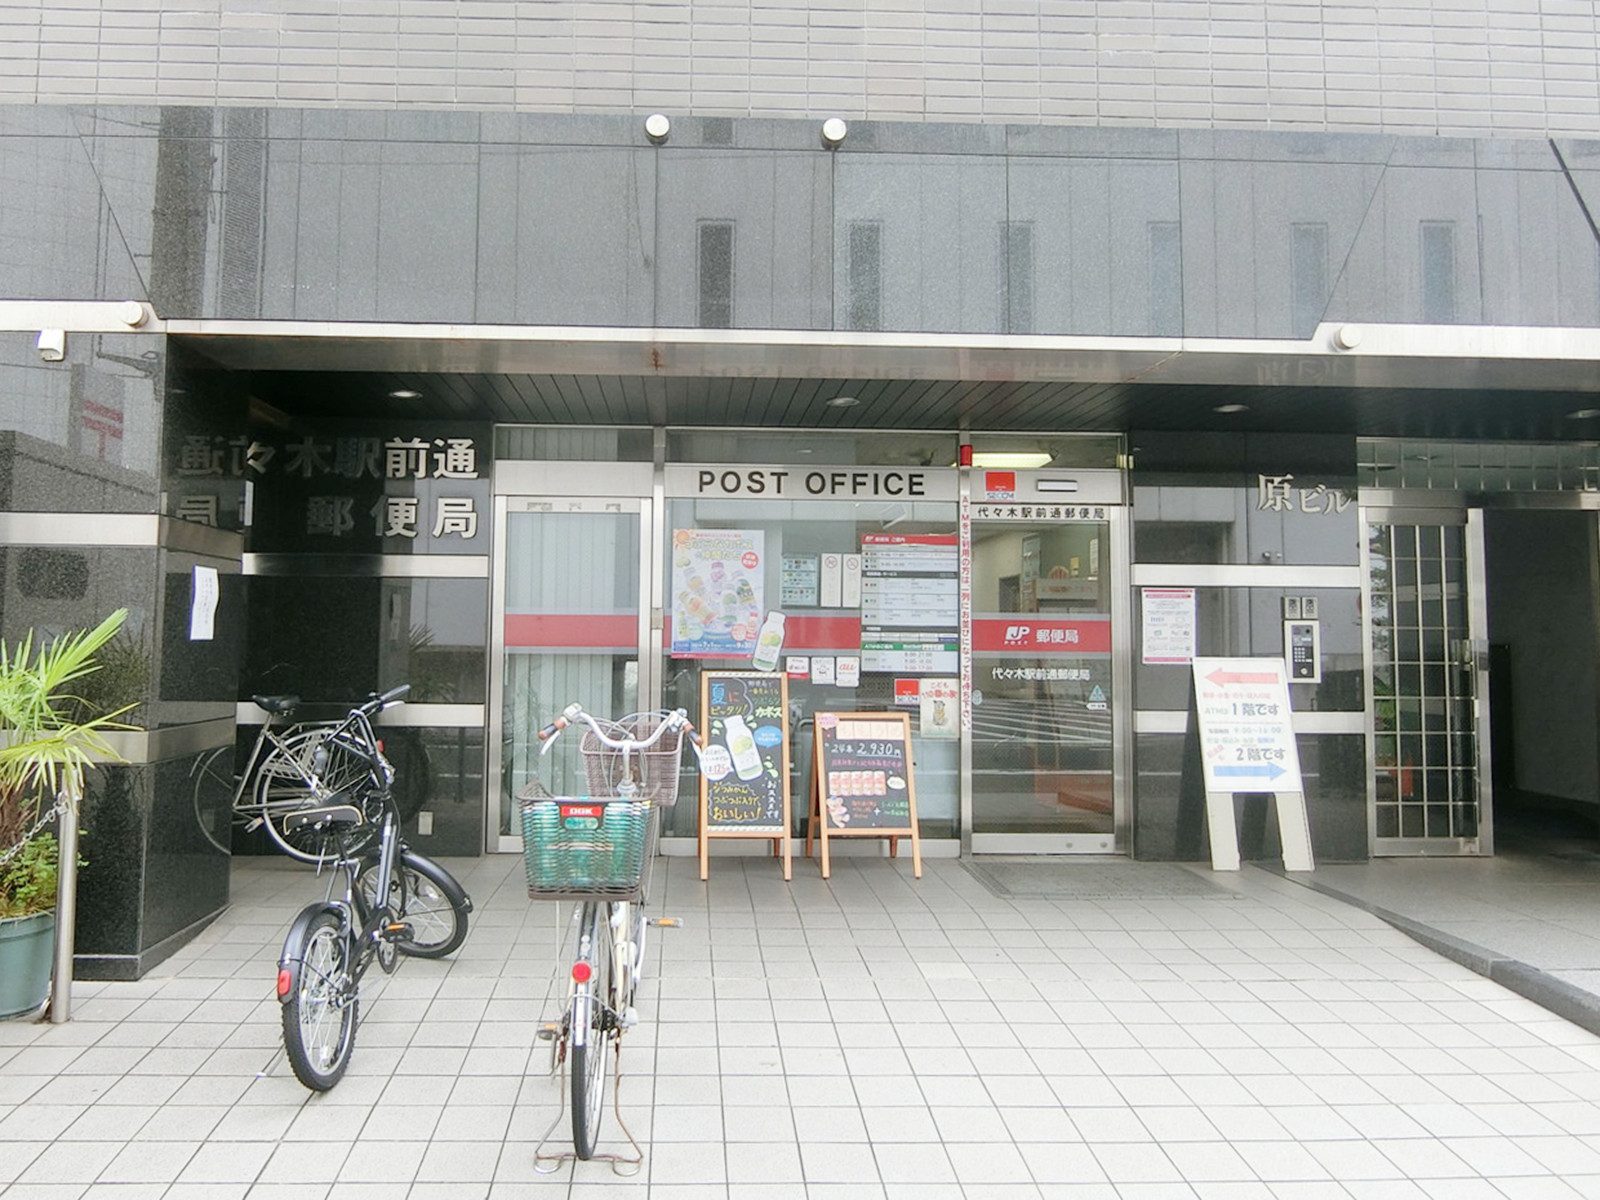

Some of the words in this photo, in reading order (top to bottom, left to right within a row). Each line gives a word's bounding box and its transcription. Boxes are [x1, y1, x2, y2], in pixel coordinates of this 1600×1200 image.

[698, 471, 789, 494] POST
[805, 472, 925, 496] OFFICE
[1257, 473, 1352, 515] 原ビル
[306, 496, 478, 539] 郵便局
[977, 507, 1105, 519] 代々木駅前通郵便局
[1006, 626, 1030, 640] JP
[1036, 629, 1079, 643] 郵便局
[992, 668, 1091, 681] 代々木駅前通郵便局
[755, 706, 783, 718] カボス
[1232, 703, 1279, 716] 1階です
[1236, 748, 1286, 761] 2階です
